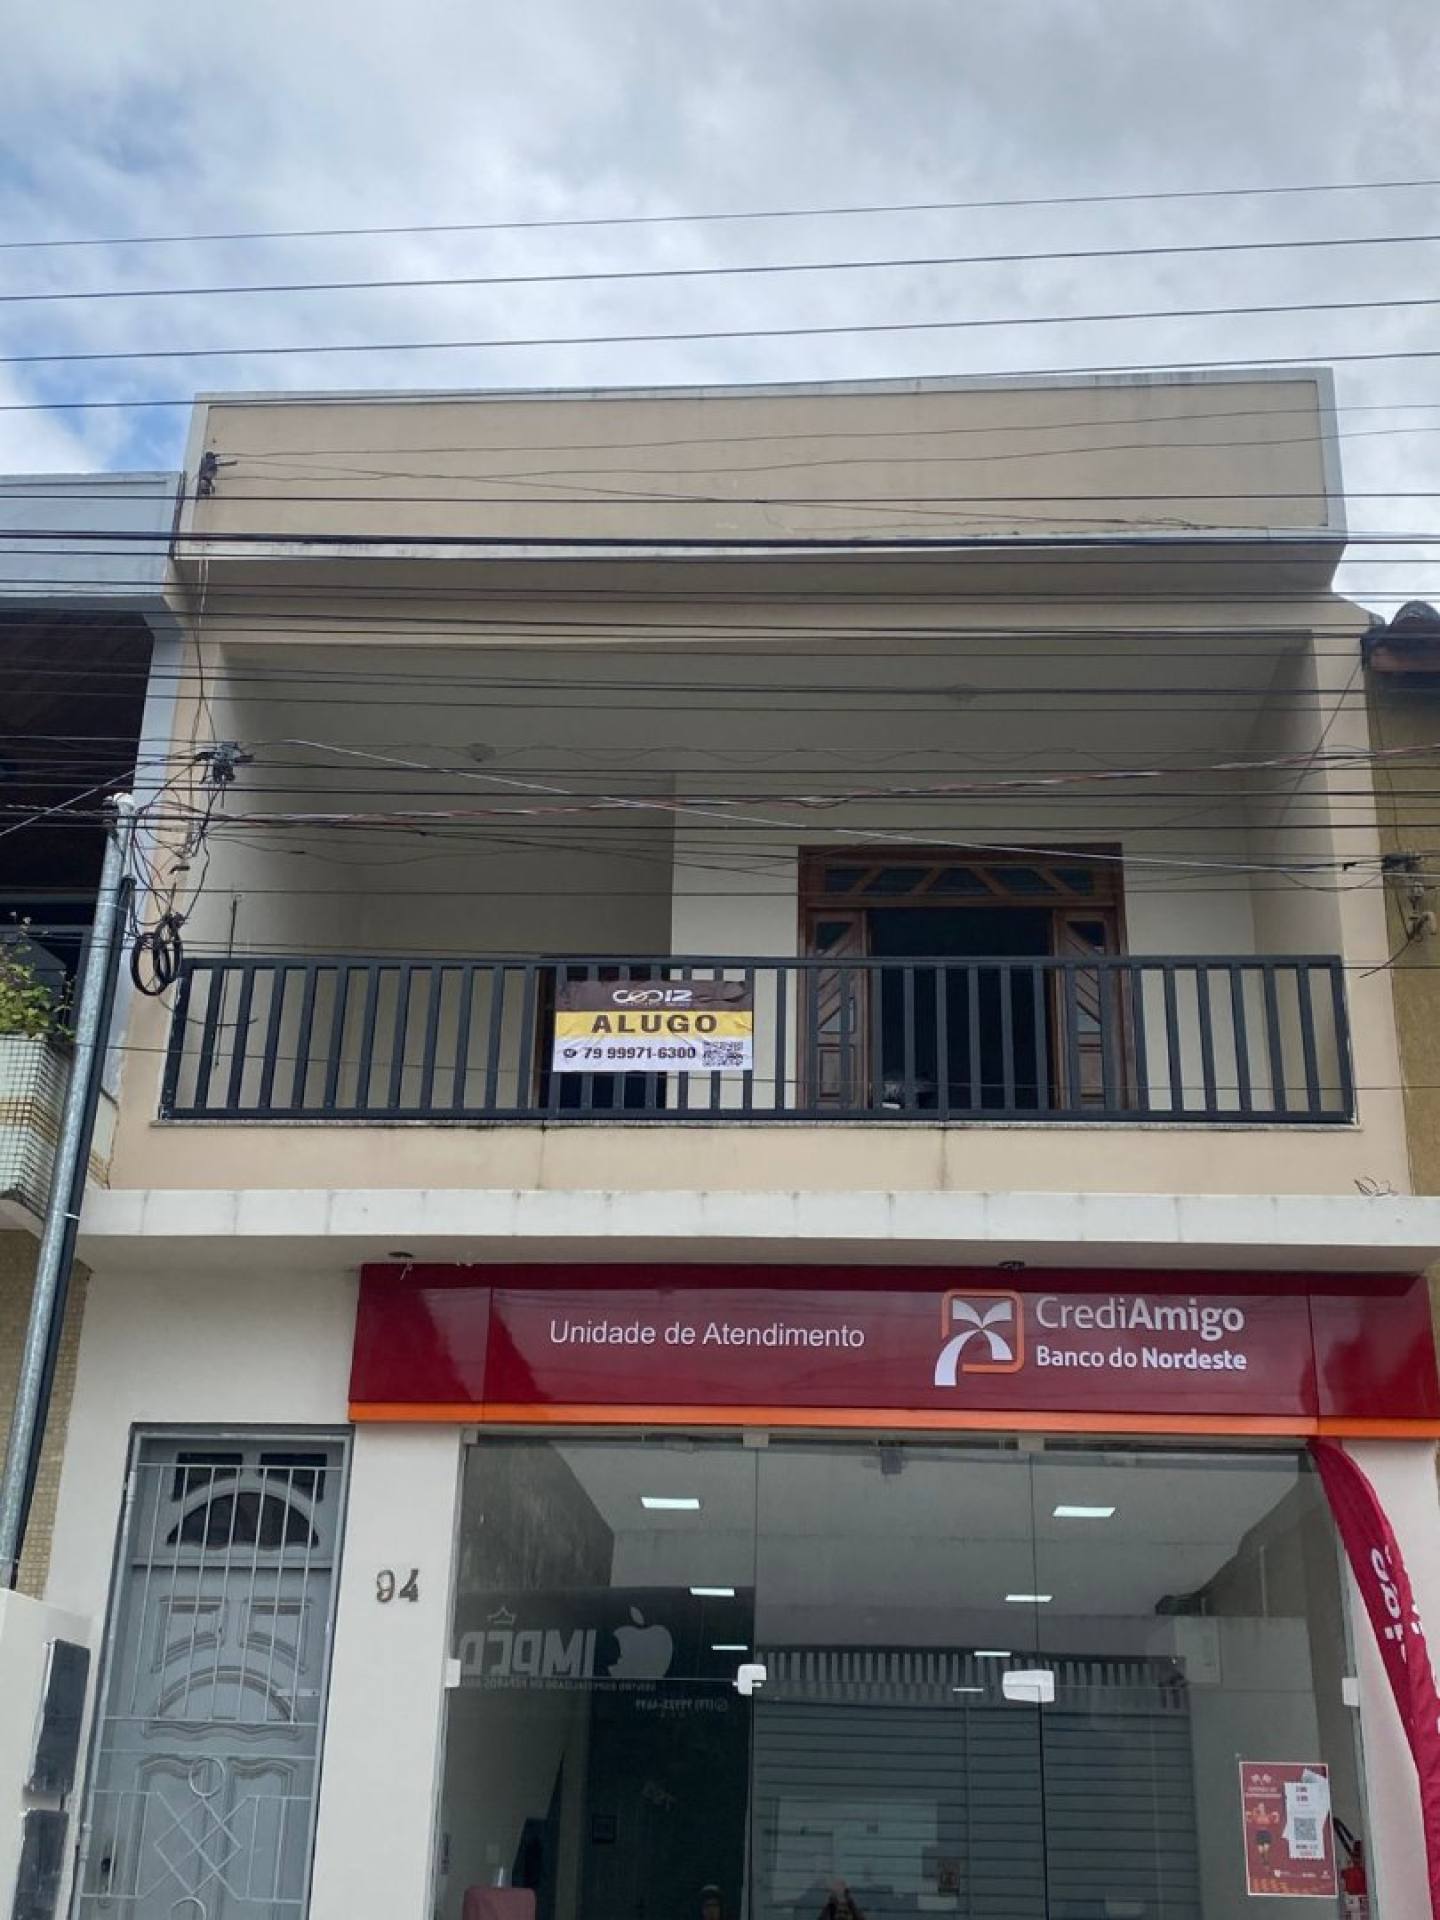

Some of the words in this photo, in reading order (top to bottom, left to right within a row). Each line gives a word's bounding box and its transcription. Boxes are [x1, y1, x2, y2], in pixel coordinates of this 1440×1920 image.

[591, 1014, 718, 1034] ALUGO
[582, 1046, 602, 1059] 79
[607, 1046, 696, 1059] 99971-6300
[1035, 1296, 1245, 1342] CrediAmigo
[550, 1319, 657, 1345] Unidade
[664, 1321, 696, 1345] de
[702, 1322, 865, 1347] Atendimento
[1035, 1344, 1105, 1367] Banco
[1109, 1346, 1137, 1368] do
[1141, 1346, 1248, 1371] Nordeste
[376, 1568, 419, 1603] 94
